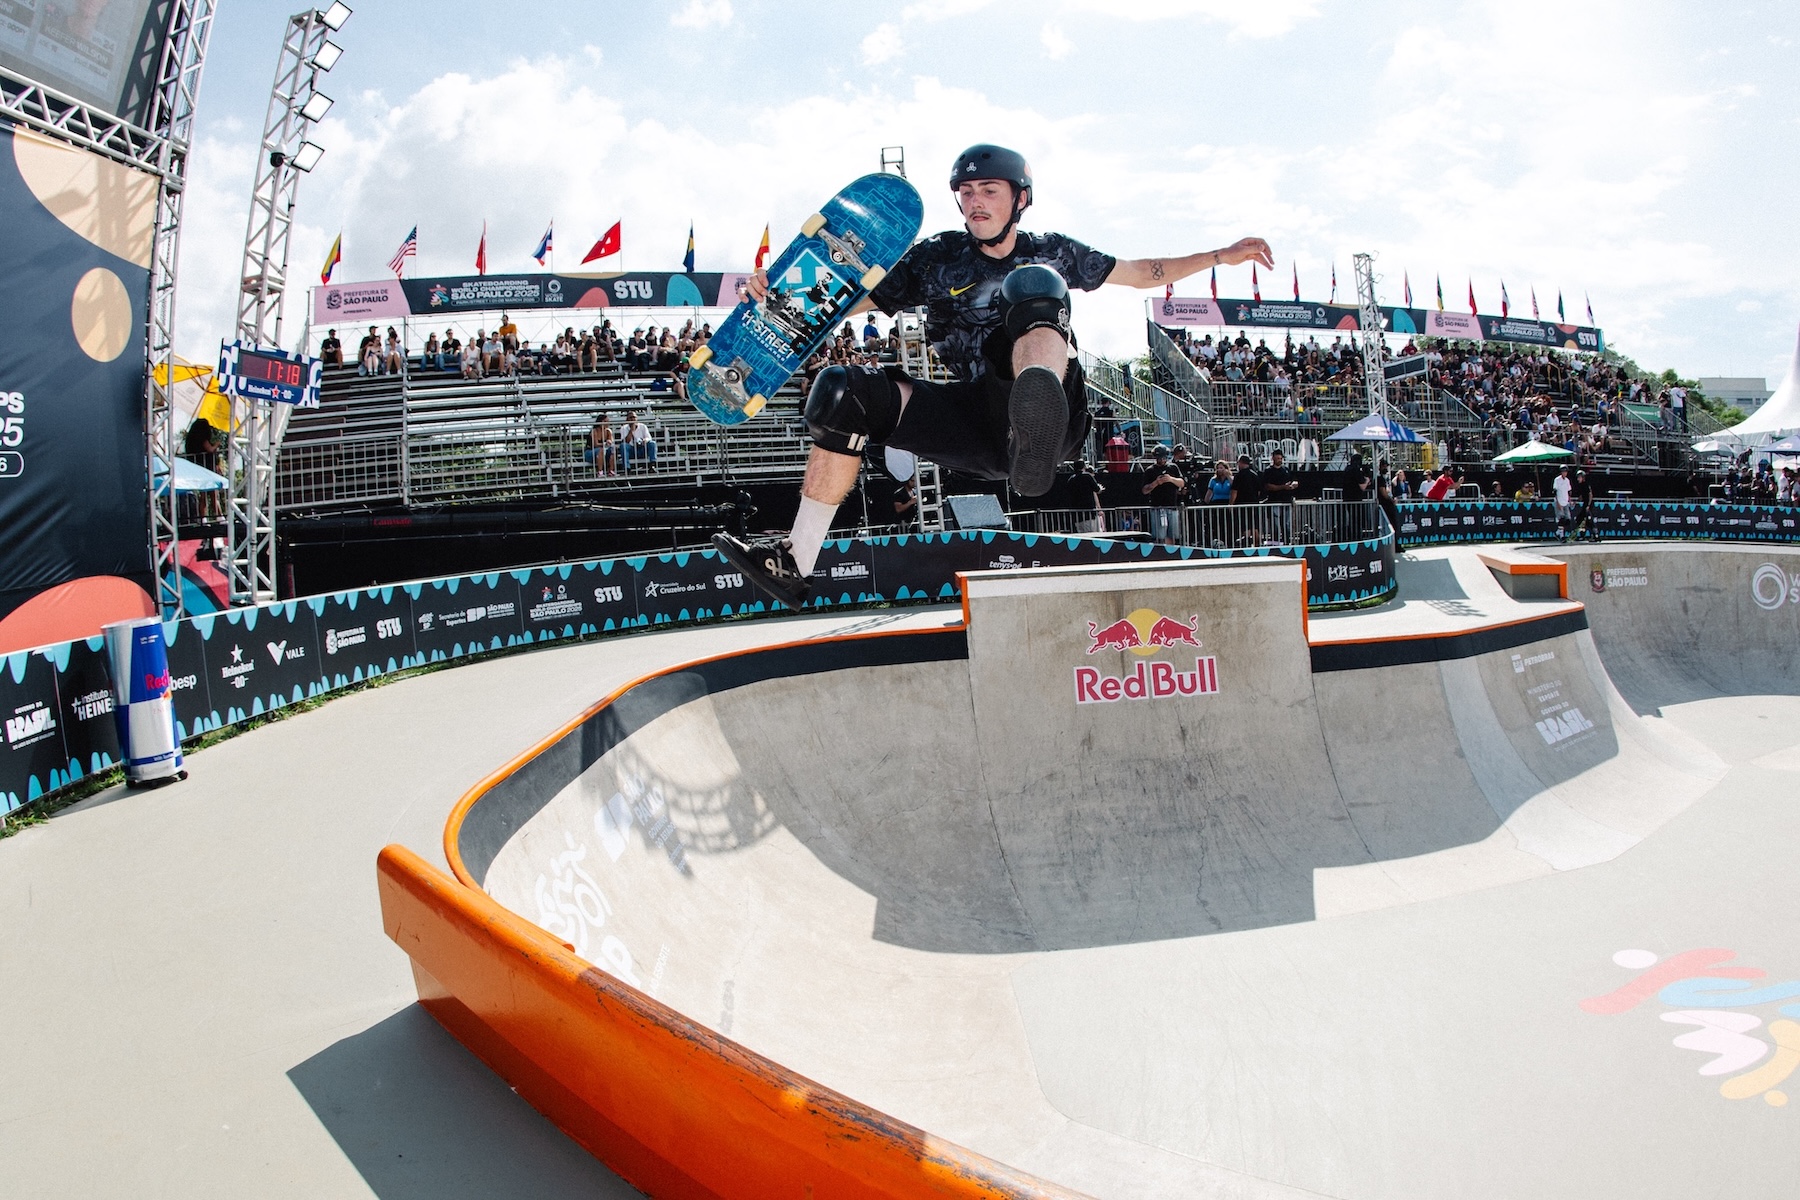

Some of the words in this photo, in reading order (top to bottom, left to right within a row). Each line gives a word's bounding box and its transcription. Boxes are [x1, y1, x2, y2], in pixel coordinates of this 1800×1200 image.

[462, 280, 529, 288] SKATEBOARDING
[480, 284, 540, 292] CHAMPIONSHIPS
[613, 280, 654, 300] STU
[343, 289, 379, 298] PREFEITURA
[343, 296, 361, 305] SÃO
[361, 295, 389, 304] PAULO
[451, 291, 476, 300] SÃO
[476, 290, 513, 299] PAULO
[513, 289, 540, 297] 2025
[741, 309, 795, 359] H-STREET
[1578, 332, 1597, 346] STU
[266, 360, 301, 386] 17:18
[1686, 516, 1699, 525] STU
[1783, 519, 1795, 528] STU
[831, 564, 869, 578] BRASIL
[1369, 560, 1383, 574] STU
[1606, 567, 1639, 576] PREFEITURA
[1639, 566, 1647, 575] DE
[714, 573, 744, 589] STU
[1607, 575, 1624, 588] SÃO
[1624, 576, 1649, 587] PAULO
[594, 586, 623, 604] STU
[660, 586, 686, 594] Cruzeiro
[686, 584, 696, 592] do
[695, 583, 707, 591] Sul
[499, 602, 514, 610] PAULO
[545, 607, 567, 617] PAULO
[376, 617, 403, 639] STU
[446, 618, 467, 627] Esportes
[337, 637, 350, 649] SÃO
[349, 634, 367, 647] PAULO
[285, 646, 306, 660] VALE
[1524, 651, 1555, 666] PETROBRAS
[221, 660, 255, 679] Heineken
[145, 669, 169, 691] Red
[1074, 661, 1148, 703] Red
[1151, 657, 1218, 698] Bull
[81, 689, 109, 705] instituto
[1538, 690, 1561, 703] ESPORTE
[1540, 703, 1563, 716] GOVERNO
[6, 706, 57, 744] BRASIL
[1535, 707, 1594, 745] BRASIL
[624, 773, 646, 805] SÃO
[633, 786, 665, 827] PAULO
[648, 814, 668, 839] GOVERNO
[659, 821, 678, 842] ESTADO
[655, 837, 665, 849] DO
[655, 943, 671, 978] ESPORTE
